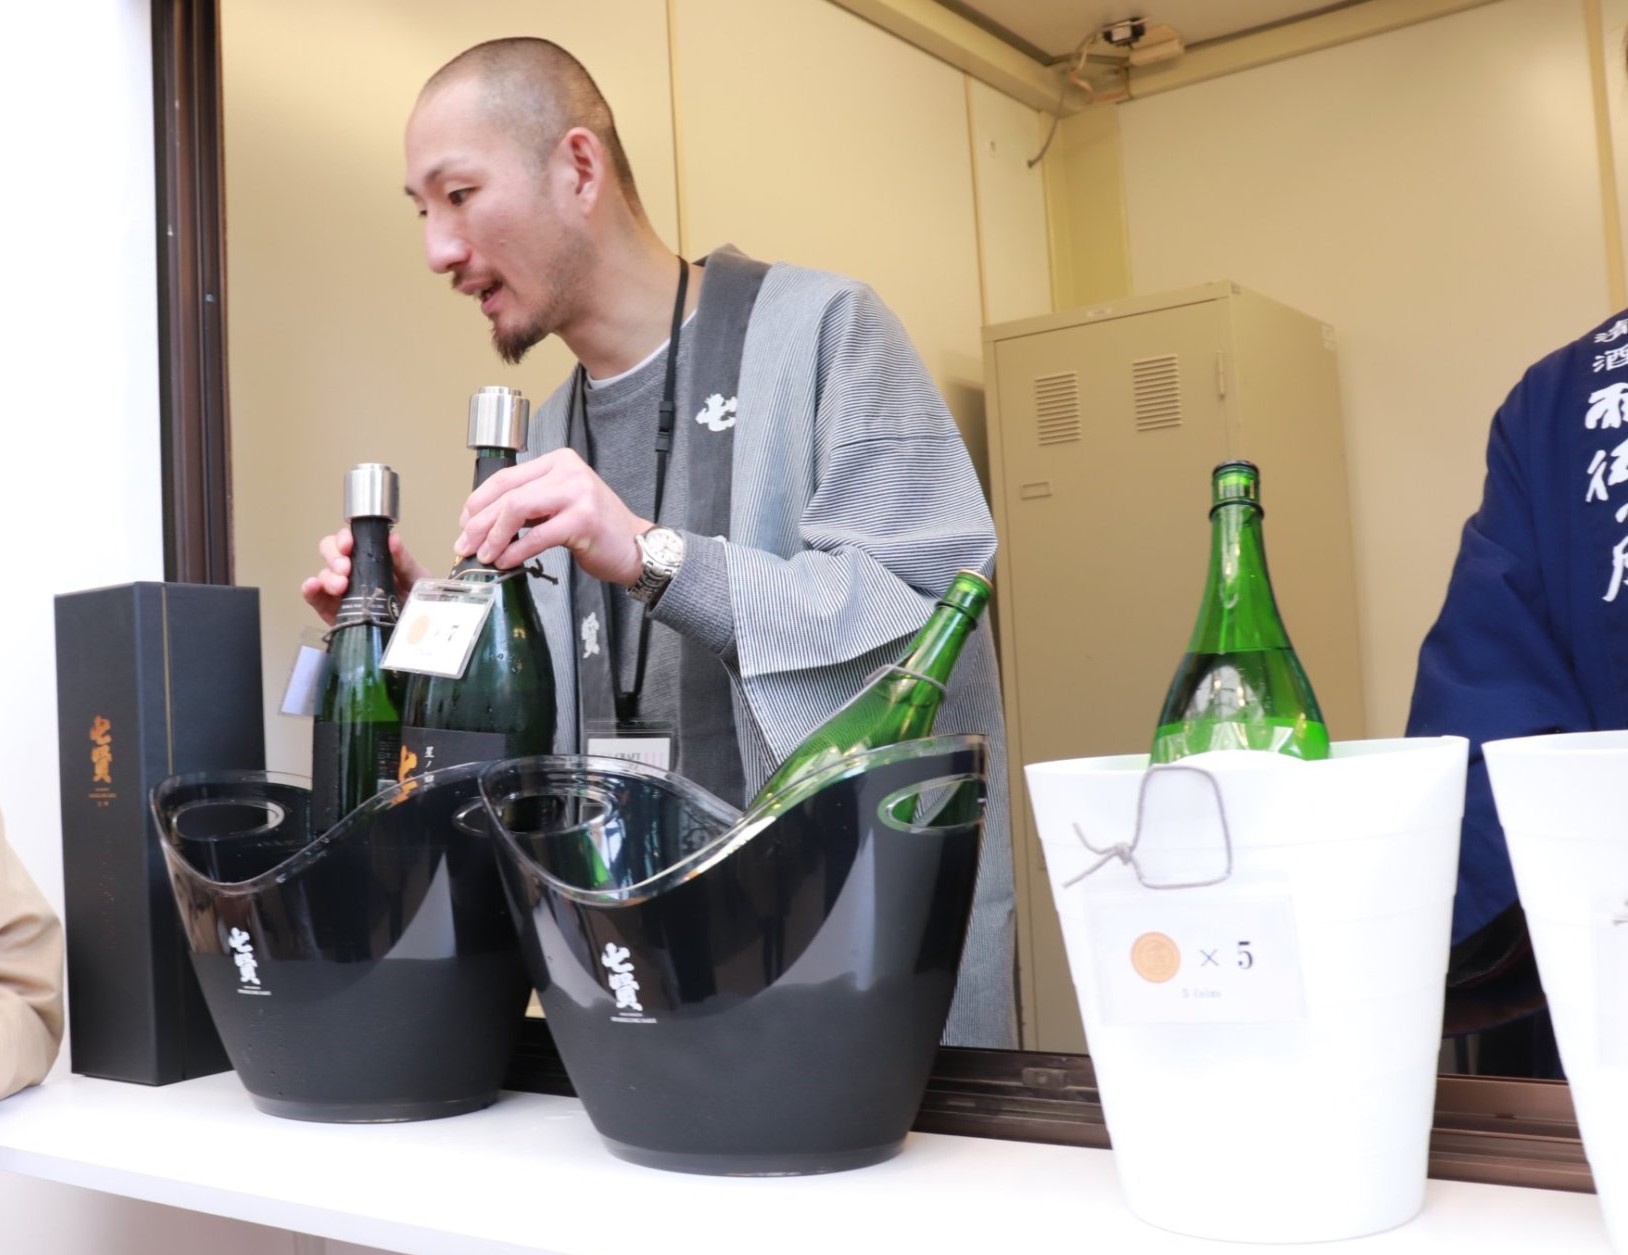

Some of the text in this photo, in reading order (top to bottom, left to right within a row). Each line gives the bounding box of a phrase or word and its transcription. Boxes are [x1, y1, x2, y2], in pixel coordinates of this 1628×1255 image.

[89, 714, 113, 784] 七賢
[228, 927, 261, 985] 七賢
[601, 942, 643, 1011] 七賢
[1237, 941, 1253, 969] 5
